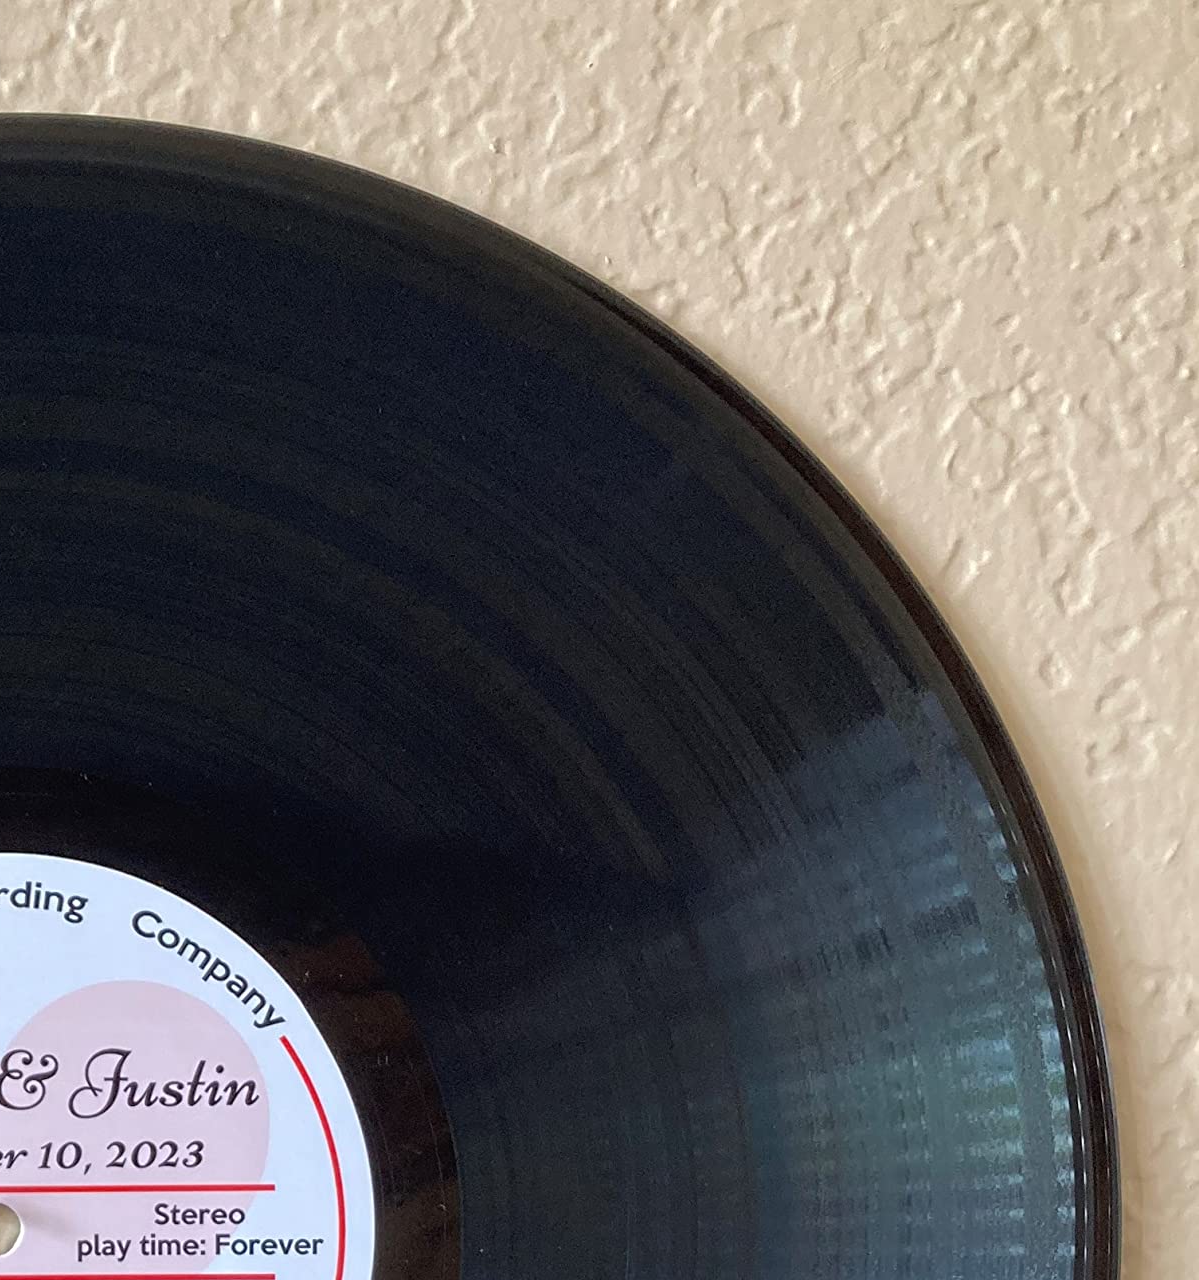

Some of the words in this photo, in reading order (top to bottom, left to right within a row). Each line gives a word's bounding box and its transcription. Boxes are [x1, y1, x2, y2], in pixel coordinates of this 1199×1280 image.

[132, 910, 286, 1029] Company
[68, 1048, 260, 1119] Justin
[38, 1141, 92, 1175] 10,
[105, 1140, 204, 1169] 2023
[154, 1203, 246, 1226] Stereo
[77, 1233, 132, 1263] play
[139, 1233, 206, 1256] time:
[215, 1233, 325, 1256] Forever
